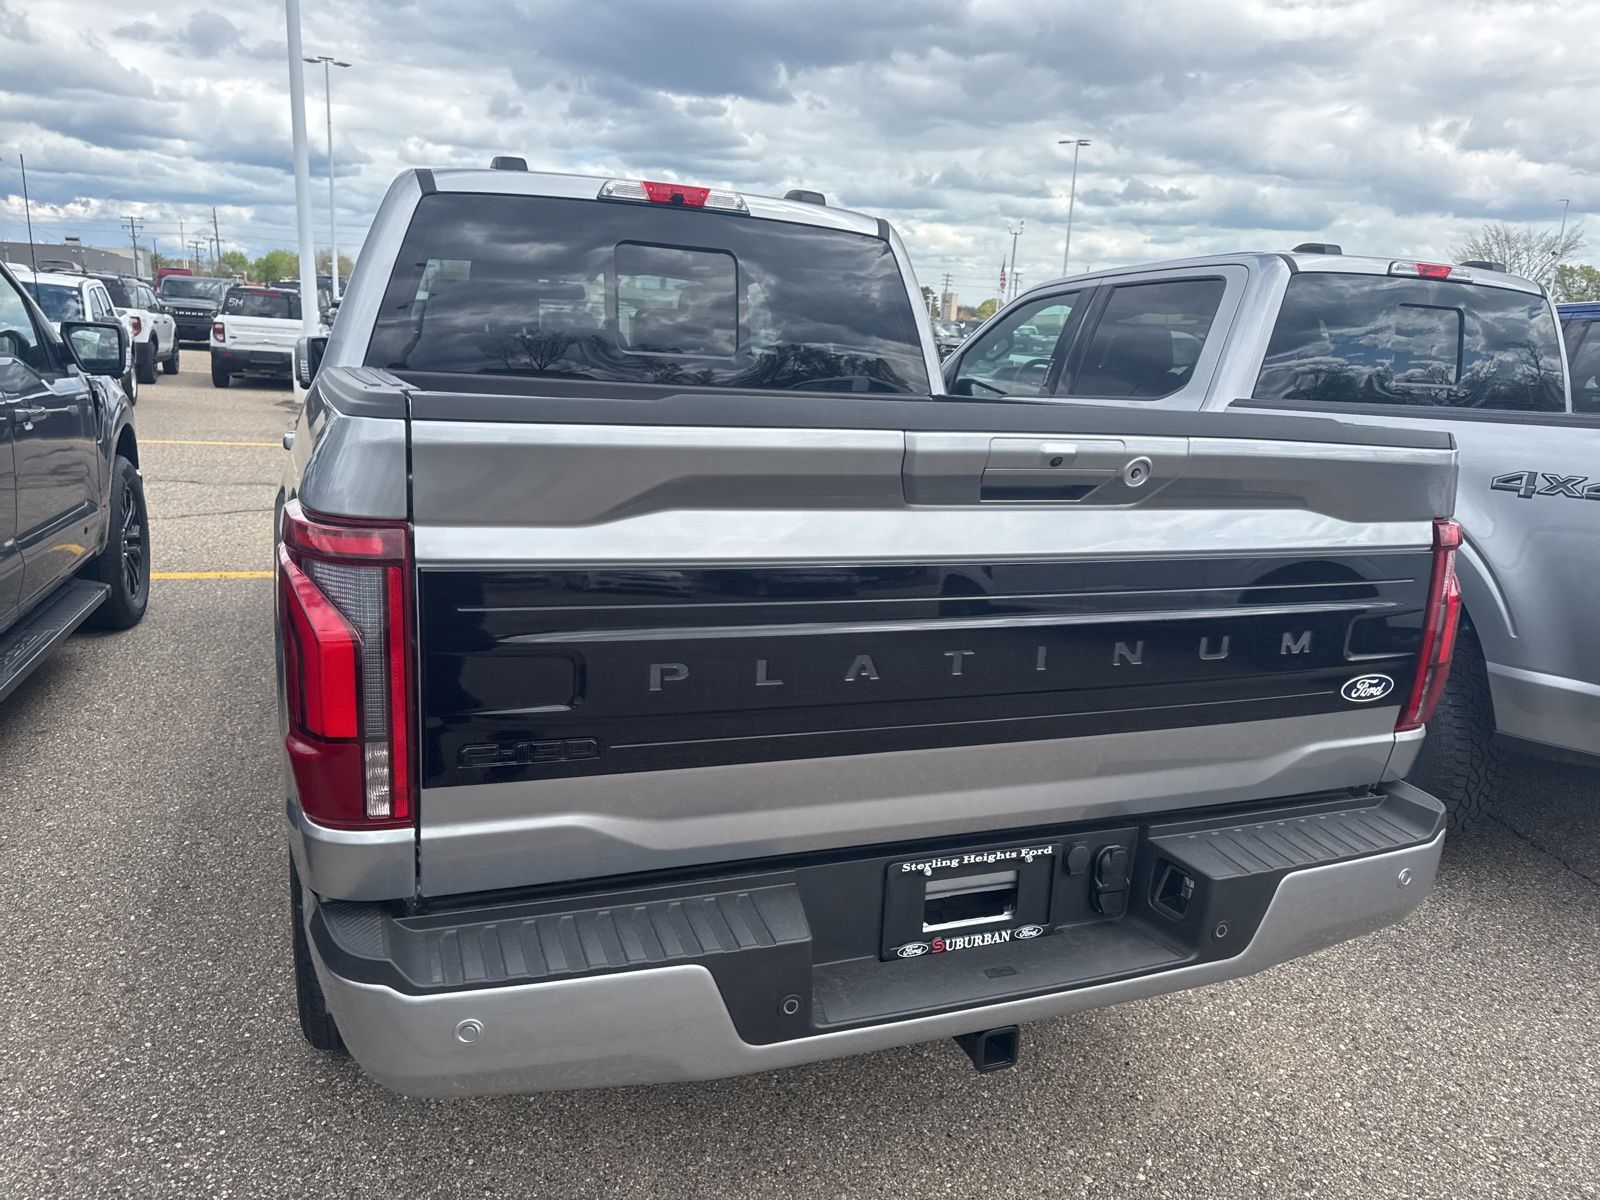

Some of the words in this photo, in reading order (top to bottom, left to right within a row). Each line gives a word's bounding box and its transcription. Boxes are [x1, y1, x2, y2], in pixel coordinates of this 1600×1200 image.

[649, 630, 1312, 691] PLATINUM
[1350, 677, 1388, 699] Ford
[901, 857, 960, 873] Sterling
[962, 850, 1018, 865] Heights
[1019, 845, 1053, 858] Ford
[931, 930, 1012, 953] SUBURBAN
